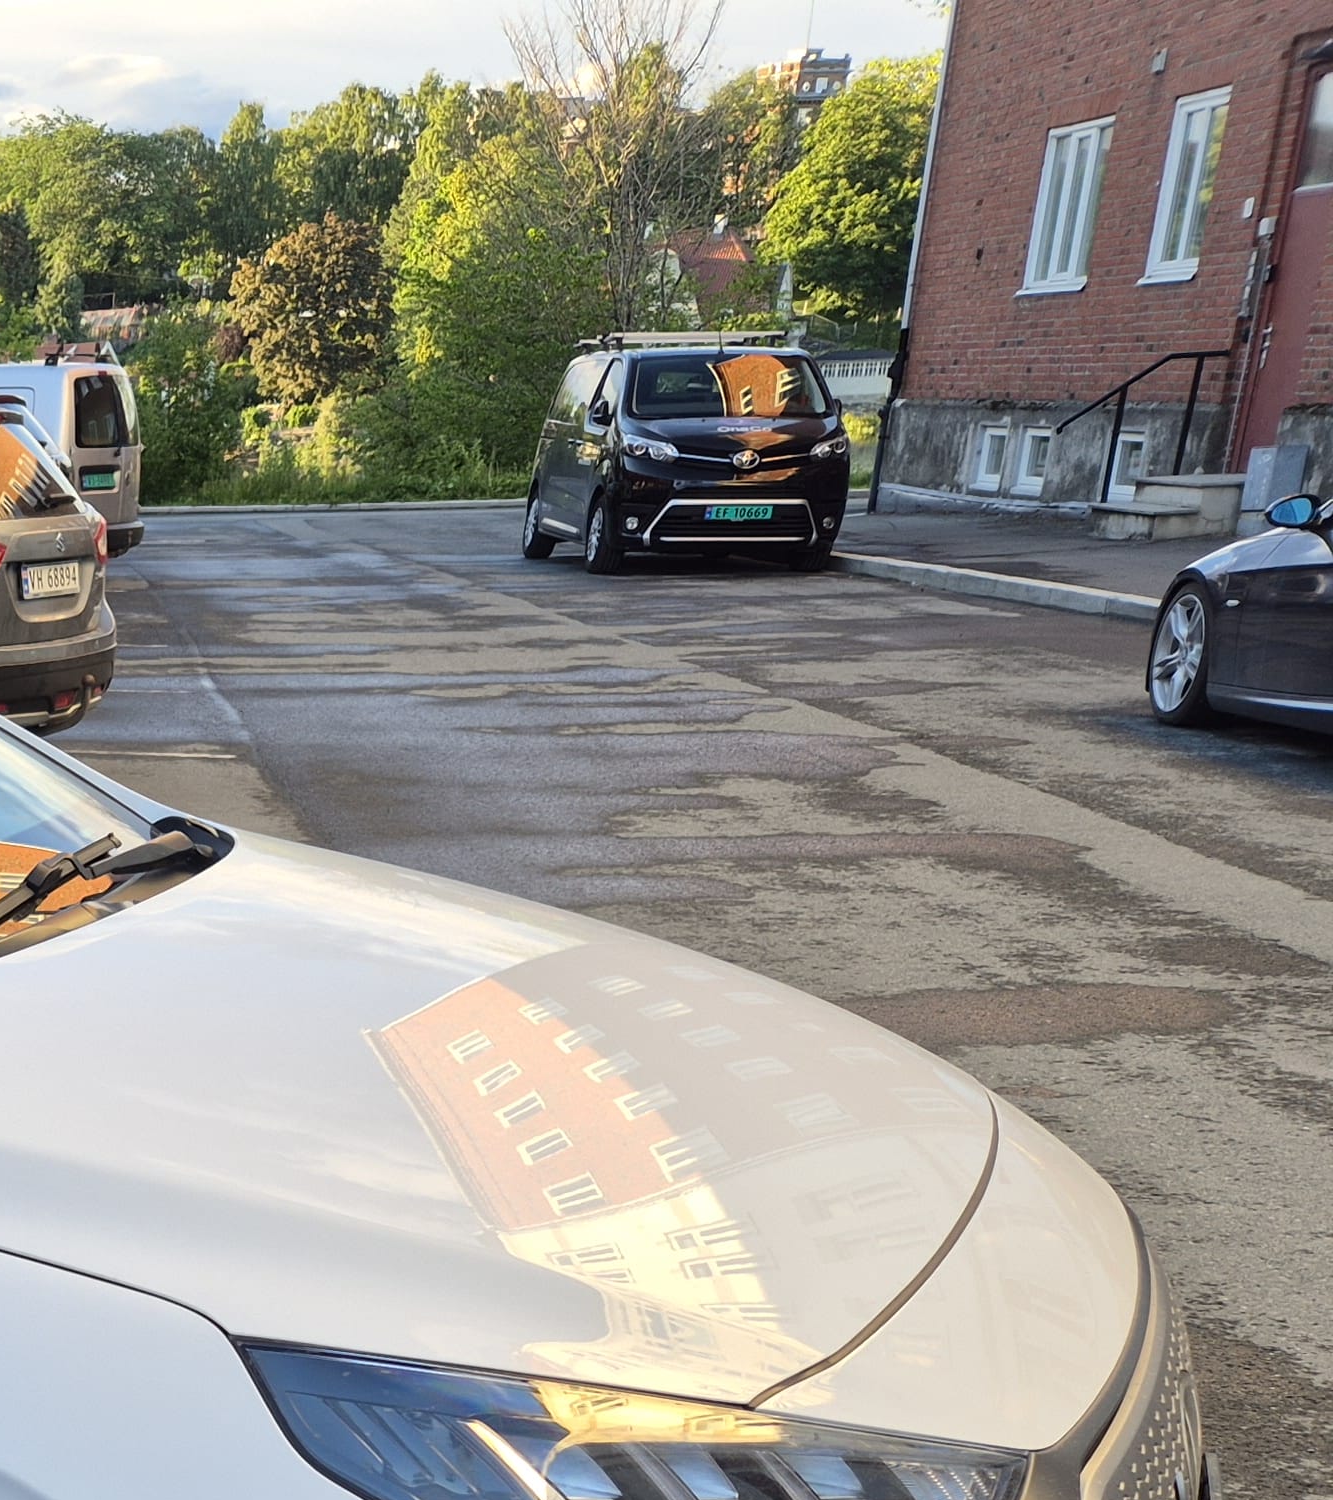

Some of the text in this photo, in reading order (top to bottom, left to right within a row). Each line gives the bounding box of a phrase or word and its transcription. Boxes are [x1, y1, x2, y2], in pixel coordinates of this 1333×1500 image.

[716, 508, 768, 518] EF 10669
[29, 566, 77, 590] VH 68894
